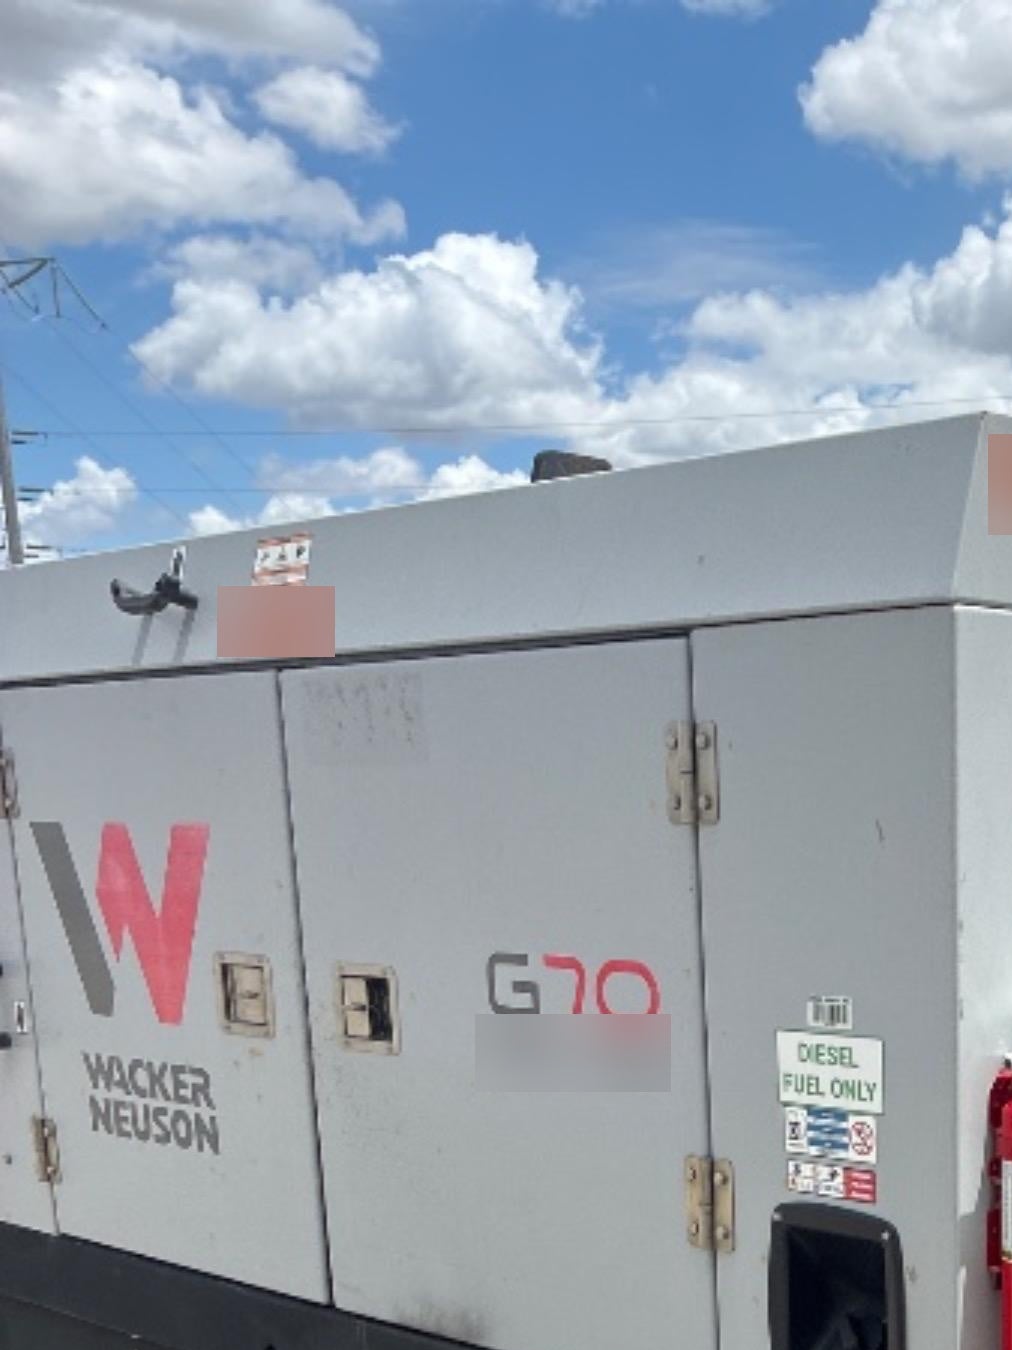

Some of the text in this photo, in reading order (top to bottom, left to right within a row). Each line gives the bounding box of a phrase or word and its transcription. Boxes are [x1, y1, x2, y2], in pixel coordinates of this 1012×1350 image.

[486, 951, 661, 1014] G70
[81, 1050, 216, 1111] WACKER
[798, 1042, 860, 1069] DIESEL
[784, 1073, 877, 1102] FUEL ONLY
[89, 1094, 220, 1155] NEUSON
